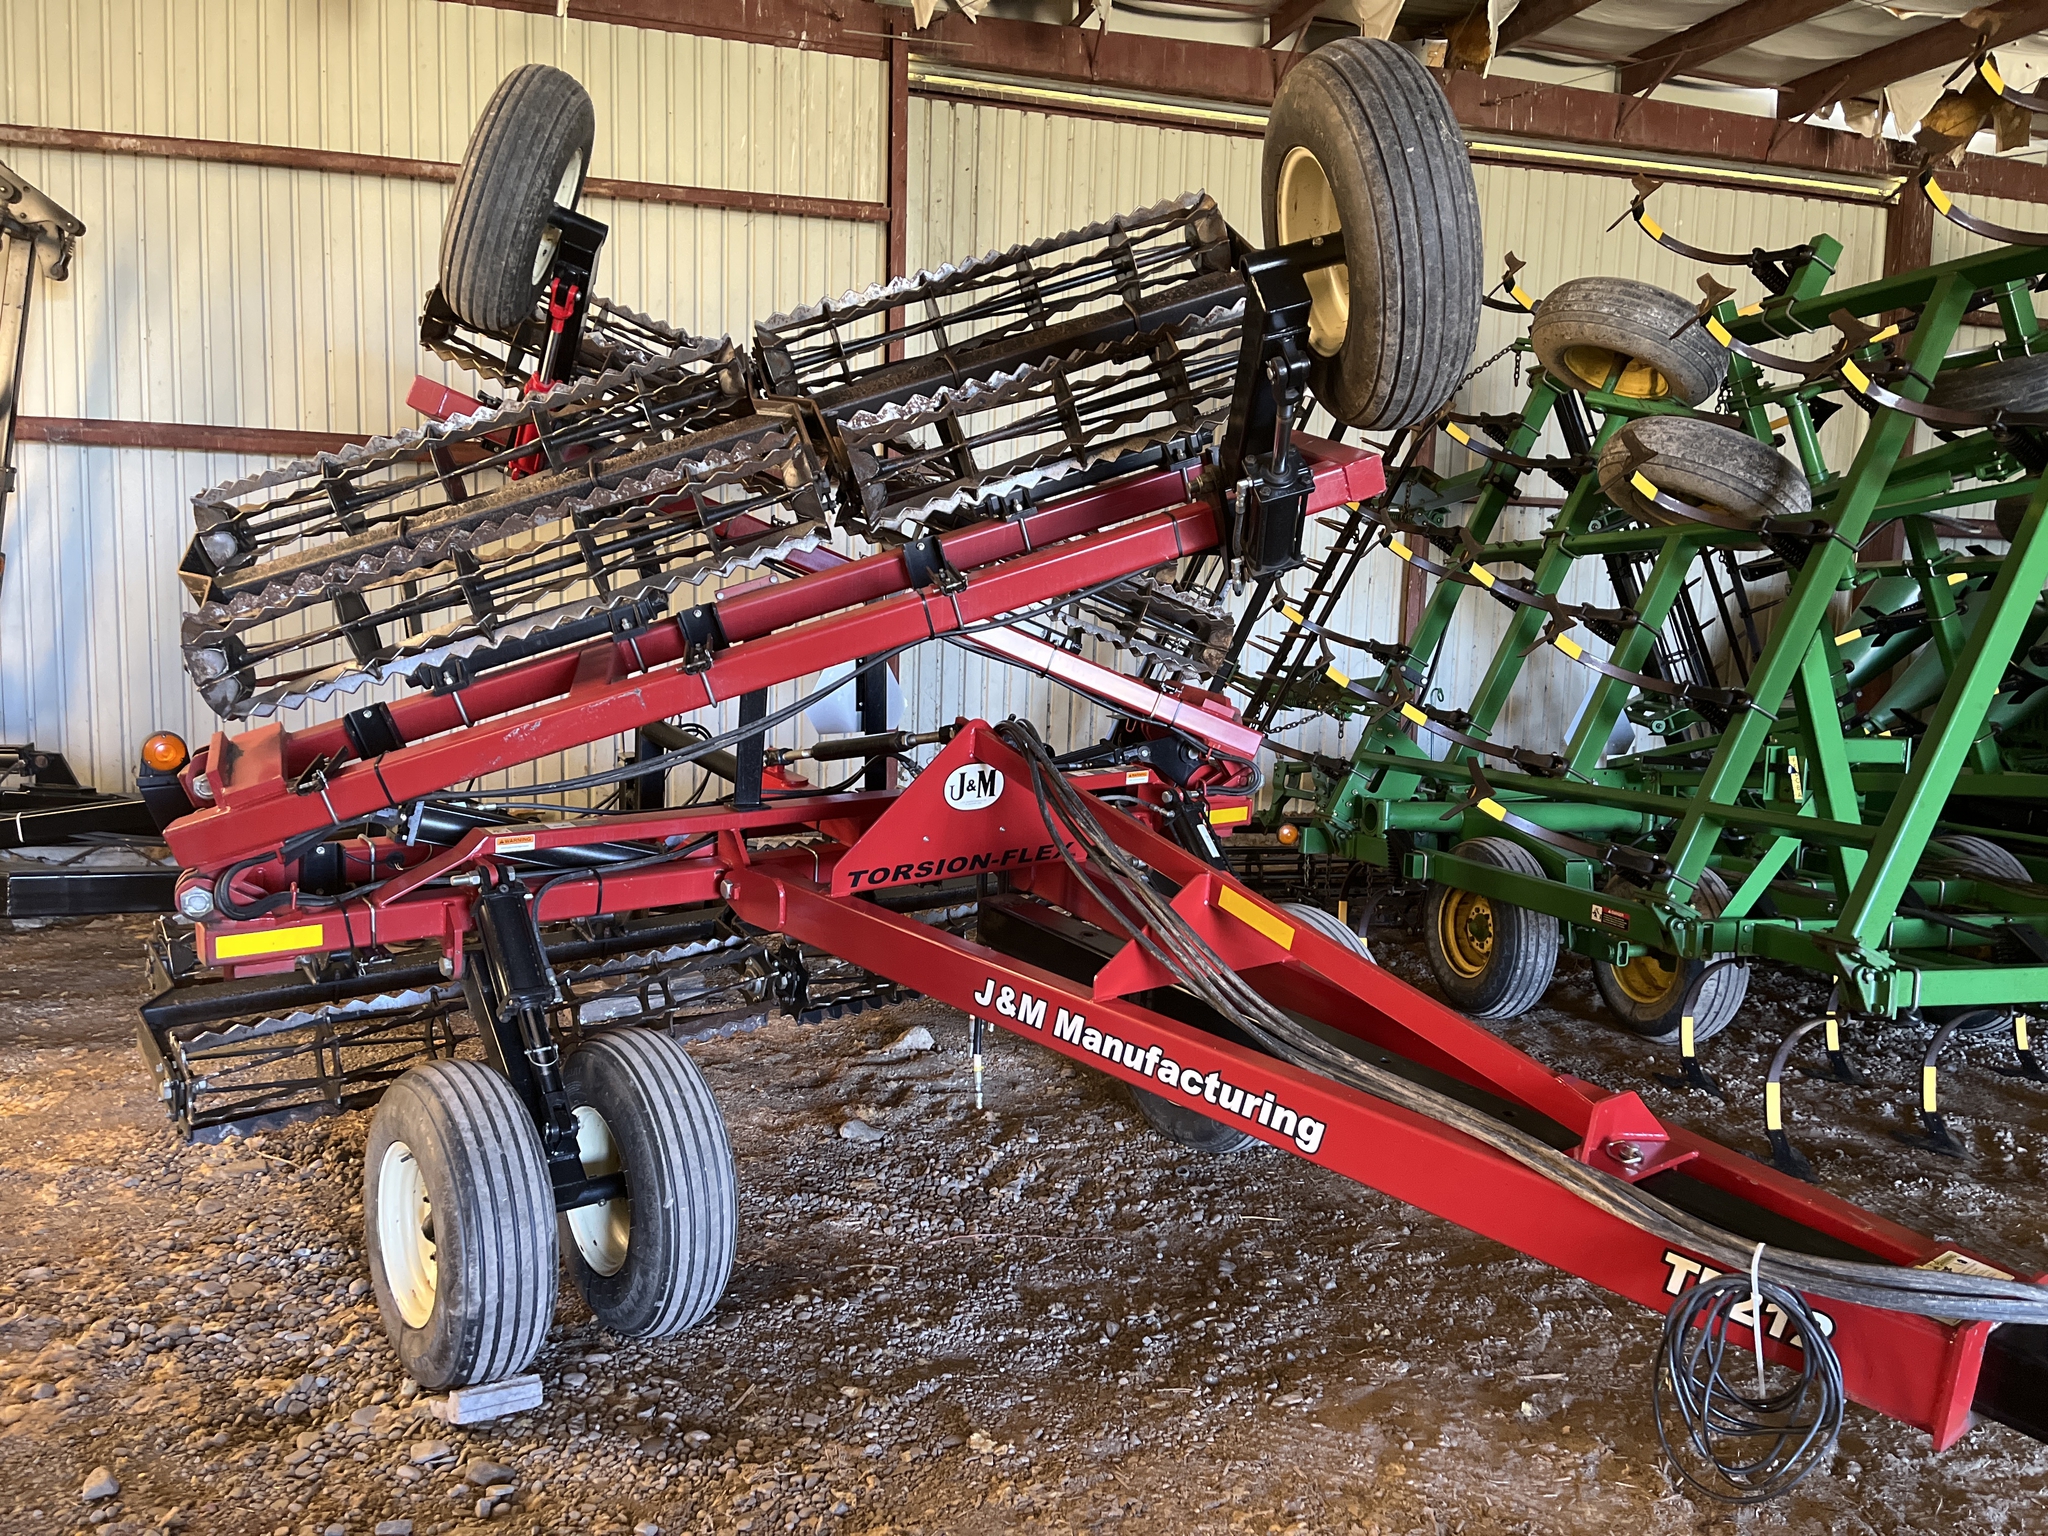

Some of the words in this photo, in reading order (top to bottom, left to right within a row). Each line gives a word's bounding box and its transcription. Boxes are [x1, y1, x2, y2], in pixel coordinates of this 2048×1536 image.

[950, 769, 997, 801] J&M
[974, 978, 1048, 1030] J&M
[1053, 1006, 1327, 1154] Manufacturing
